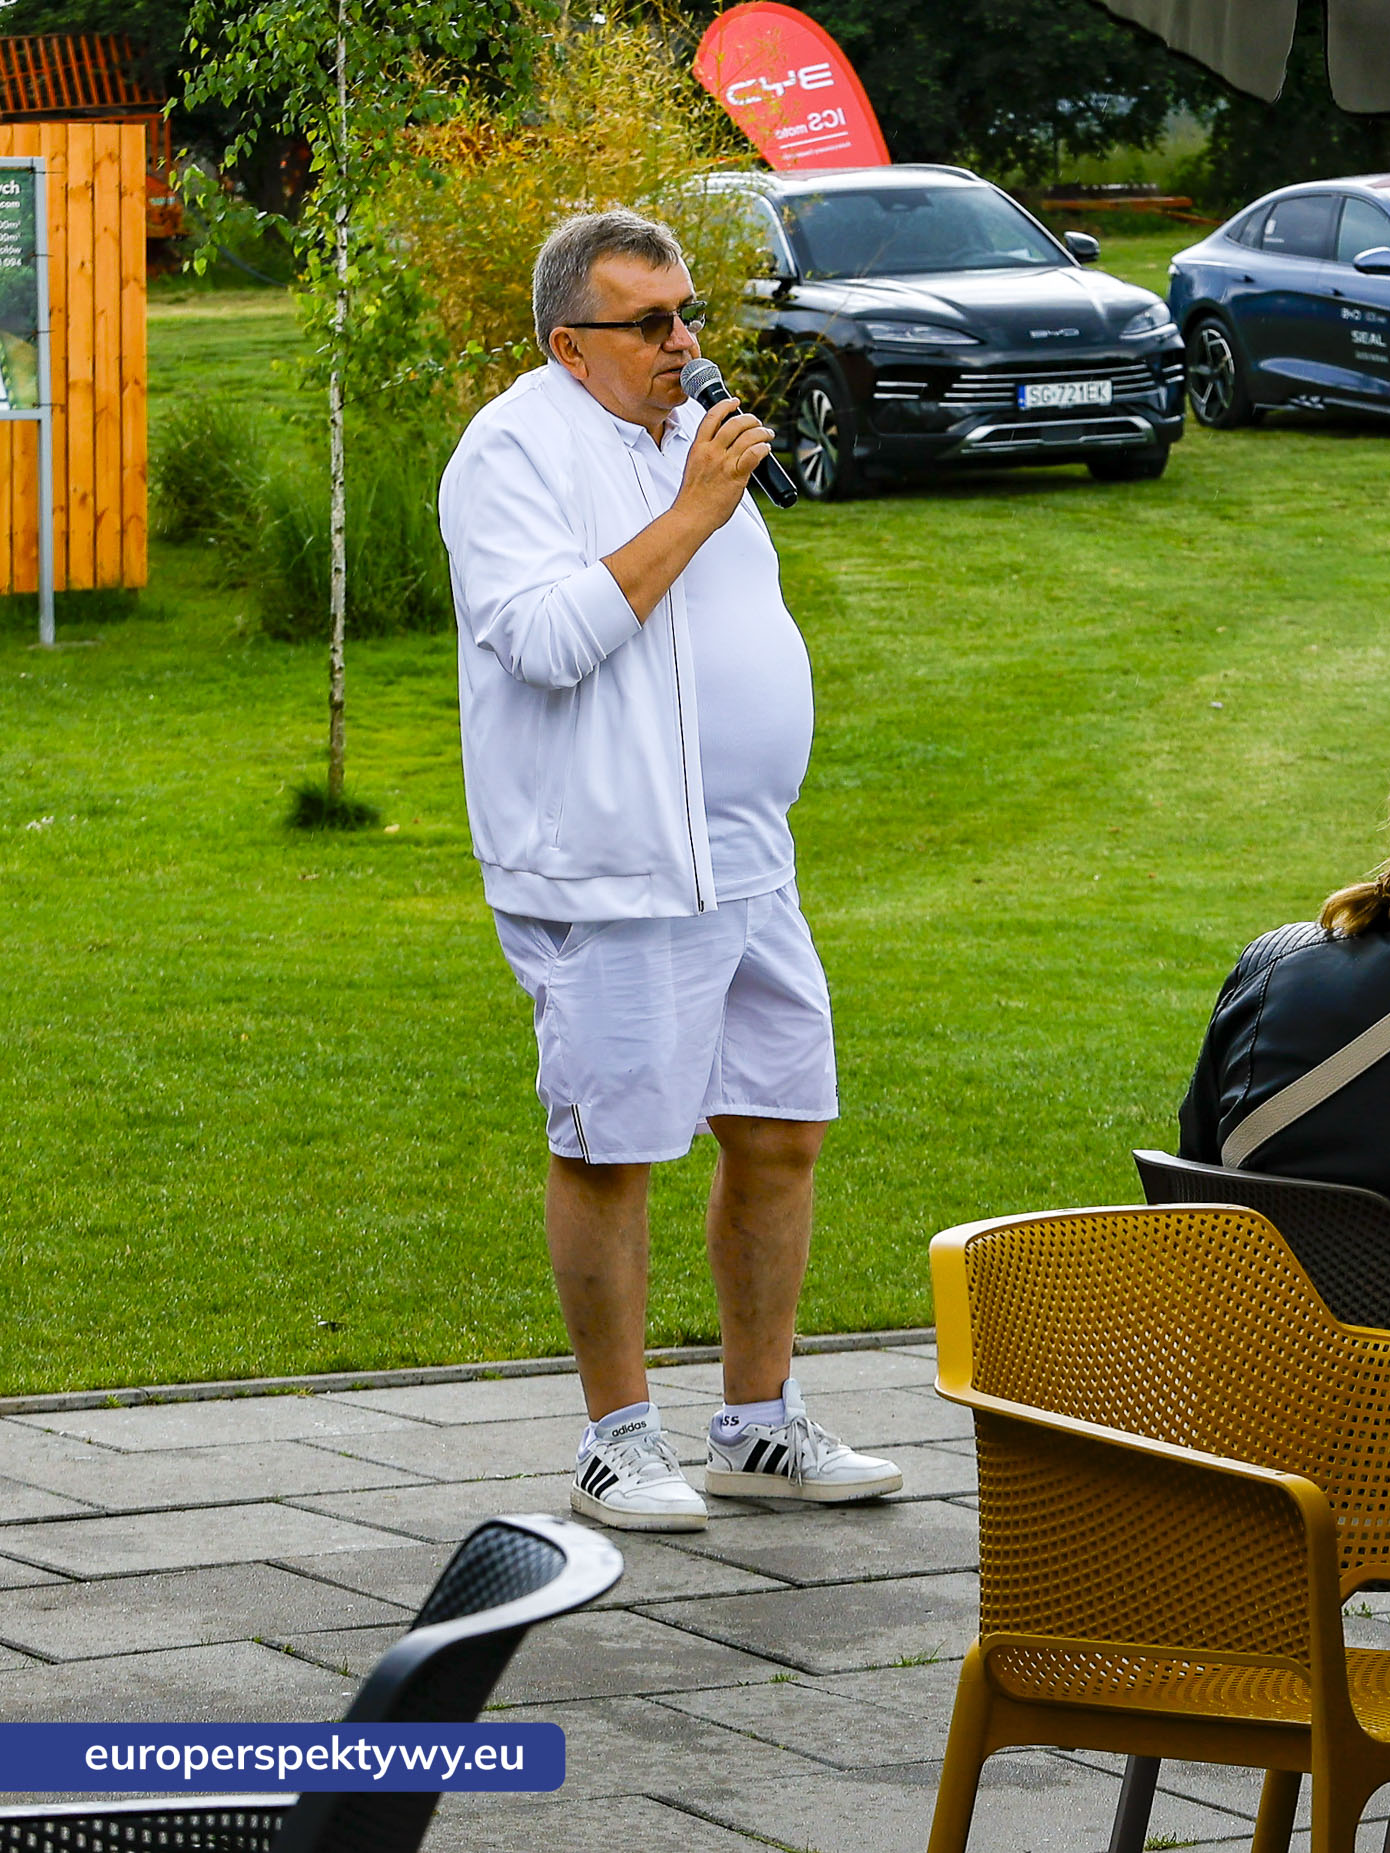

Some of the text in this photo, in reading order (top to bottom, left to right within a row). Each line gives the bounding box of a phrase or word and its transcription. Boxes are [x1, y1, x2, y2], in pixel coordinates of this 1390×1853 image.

[1350, 330, 1388, 348] SEAL
[1029, 386, 1052, 404] SG
[611, 1420, 647, 1437] adidas
